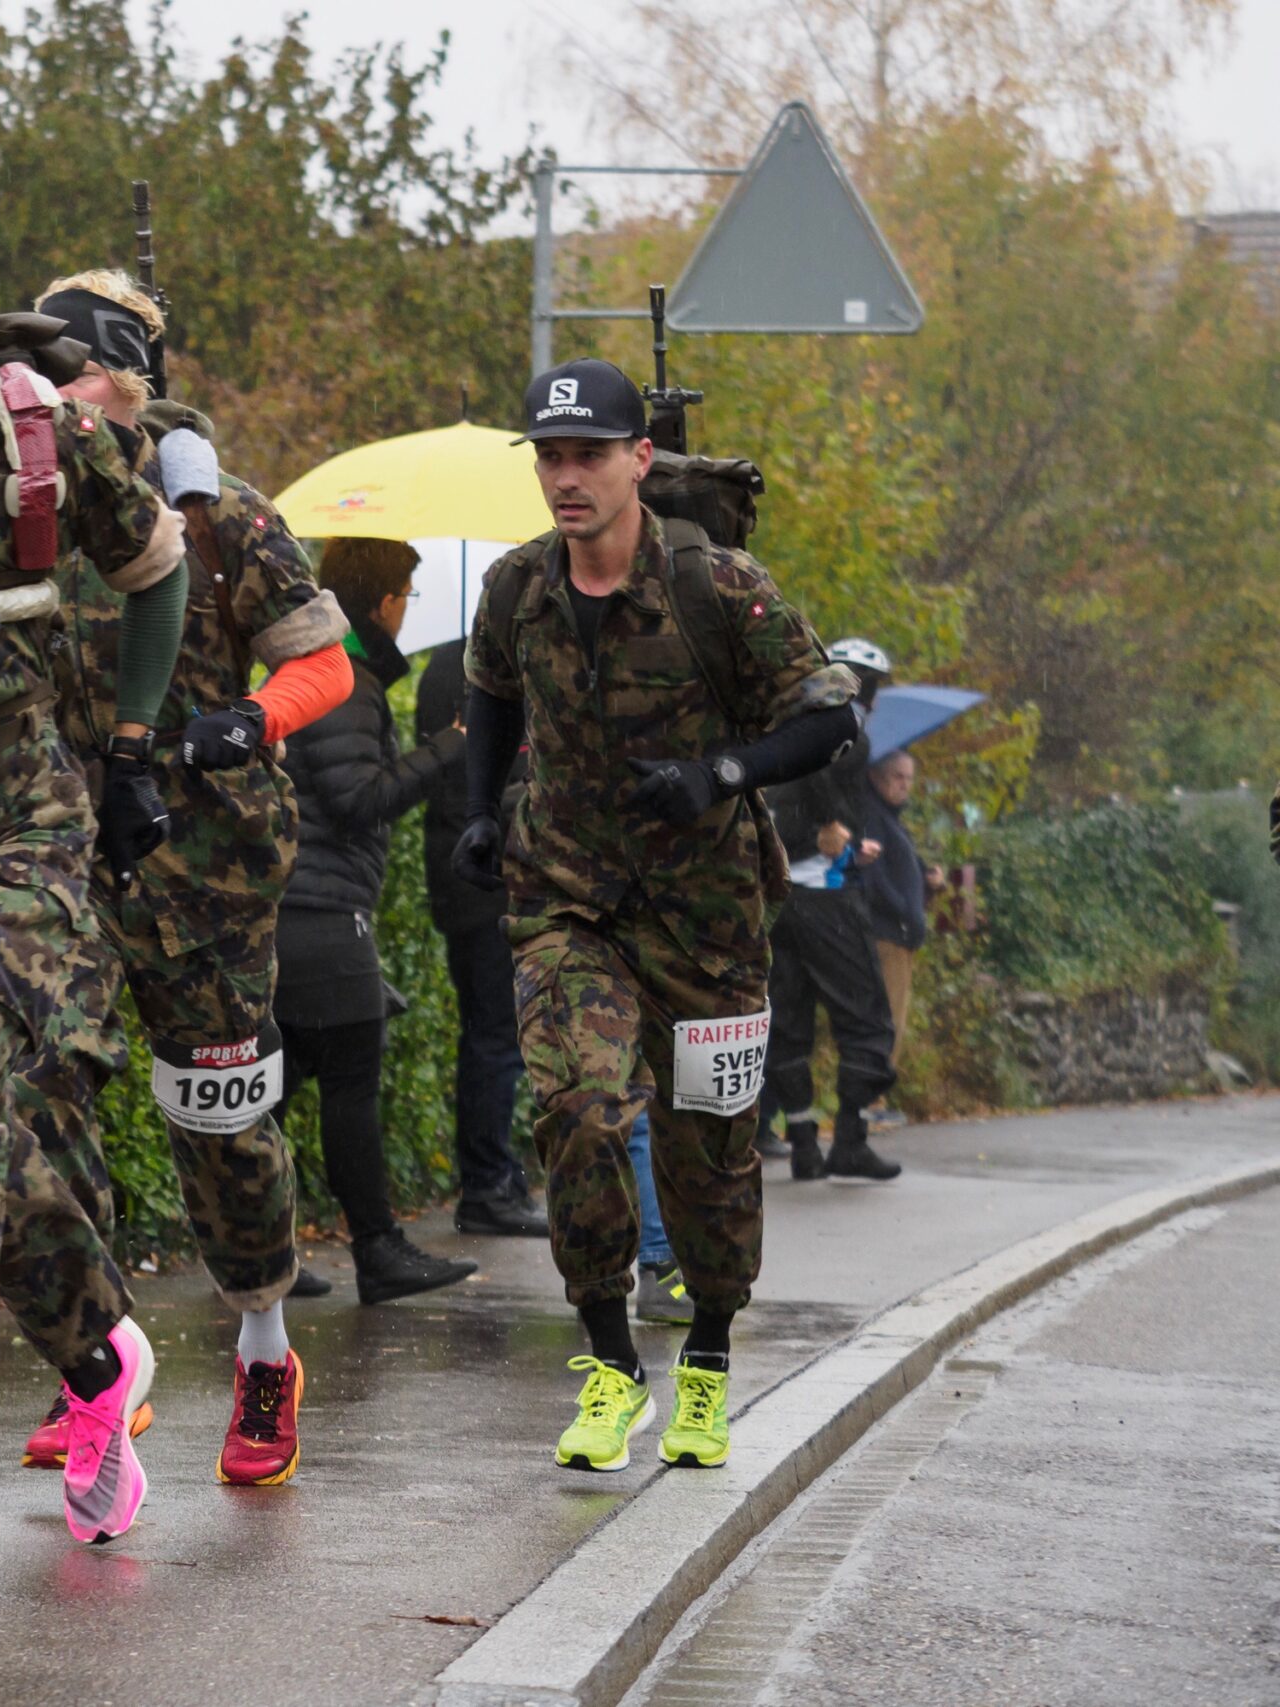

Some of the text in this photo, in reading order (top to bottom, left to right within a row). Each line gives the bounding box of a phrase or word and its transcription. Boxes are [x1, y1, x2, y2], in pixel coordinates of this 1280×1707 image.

[536, 405, 592, 421] salomon
[191, 1036, 259, 1061] SPORTXX
[713, 1042, 765, 1073] SVEN
[175, 1069, 266, 1110] 1906
